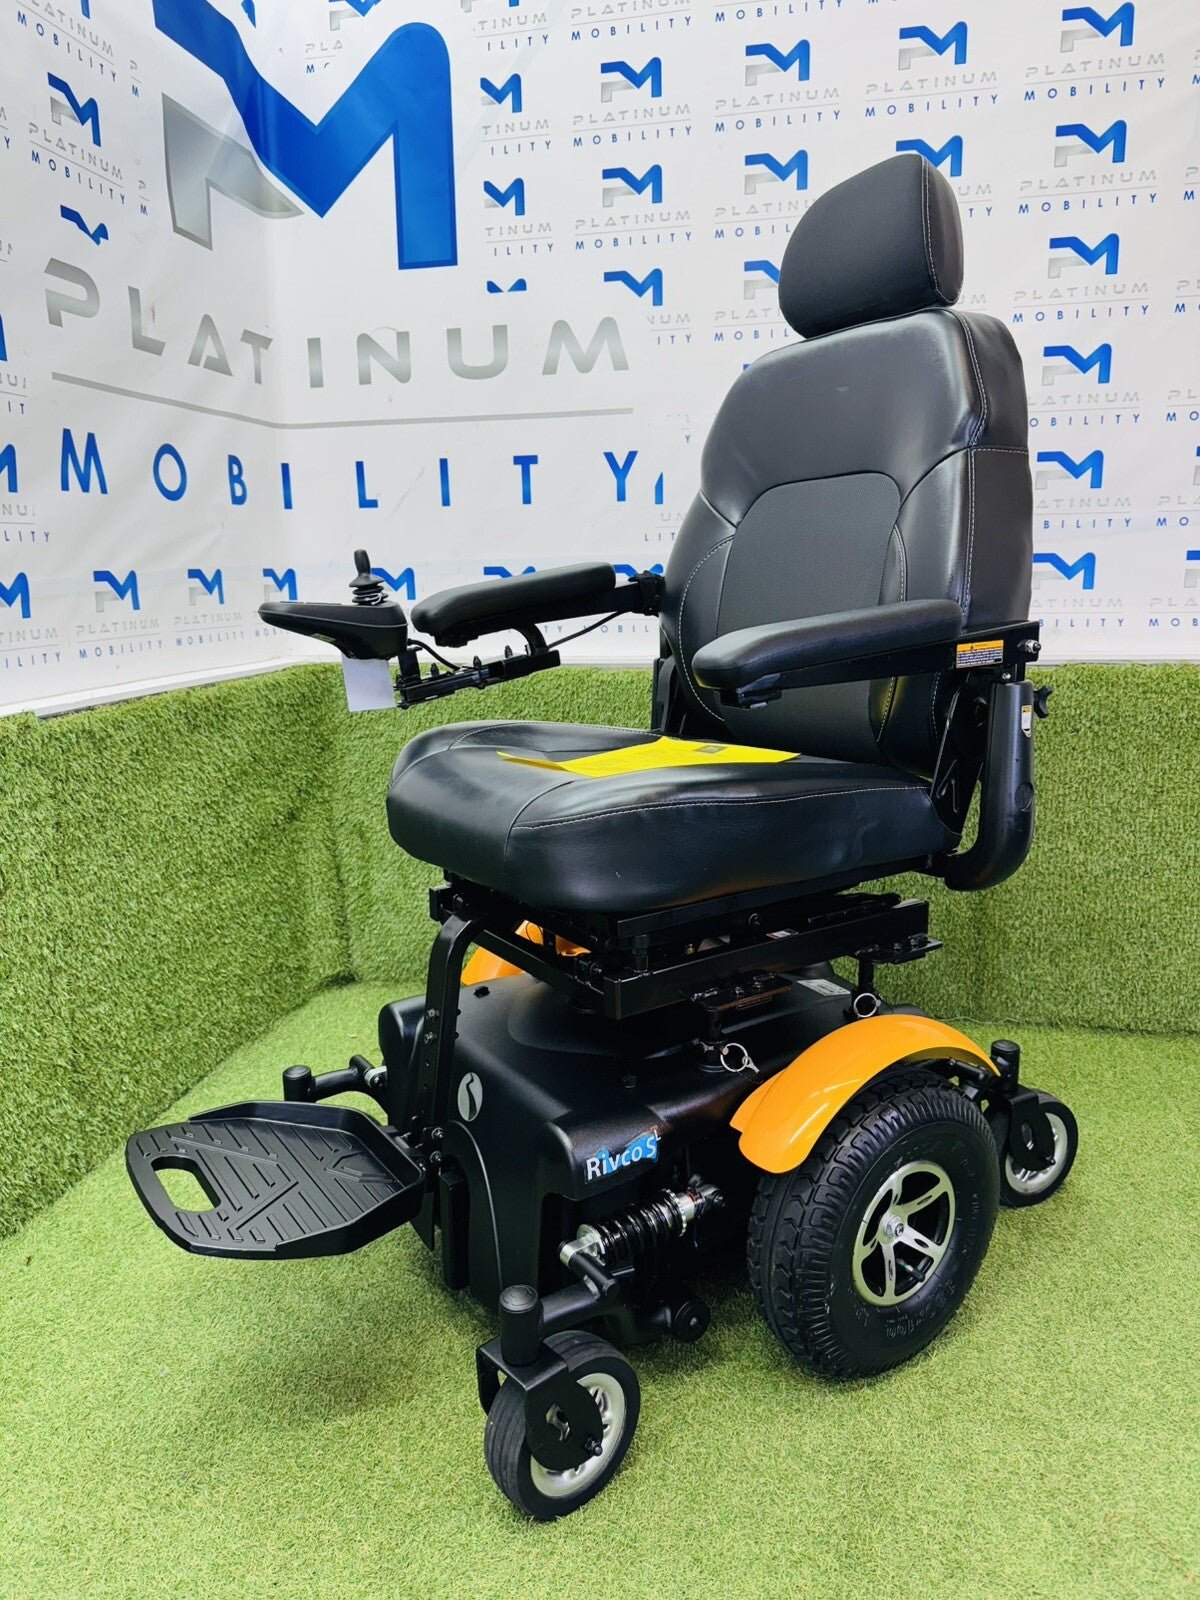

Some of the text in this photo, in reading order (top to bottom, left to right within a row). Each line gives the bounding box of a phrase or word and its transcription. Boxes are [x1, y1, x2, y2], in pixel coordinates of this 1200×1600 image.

[570, 16, 692, 41] MOBILITY
[17, 10, 117, 82] MOBILITY
[1025, 52, 1165, 78] PLATINUM
[865, 70, 997, 95] PLATINUM
[1024, 77, 1165, 101] MOBILITY
[715, 87, 839, 110] PLATINUM
[865, 94, 998, 117] MOBILITY
[573, 103, 690, 126] PLATINUM
[715, 110, 841, 133] MOBILITY
[573, 125, 692, 147] MOBILITY
[29, 122, 123, 181] PLATINUM
[32, 150, 125, 205] MOBILITY
[1019, 168, 1157, 192] PLATINUM
[1018, 193, 1157, 214] MOBILITY
[575, 209, 691, 230] PLATINUM
[575, 231, 692, 250] MOBILITY
[1013, 282, 1149, 301] PLATINUM
[44, 257, 629, 388] PLATINUM
[1013, 305, 1149, 323] MOBILITY
[61, 428, 638, 510] MOBILITY
[76, 618, 160, 636] PLATINUM
[174, 612, 242, 626] PLATINUM
[79, 640, 163, 659] MOBILITY
[586, 1146, 642, 1181] Rivco
